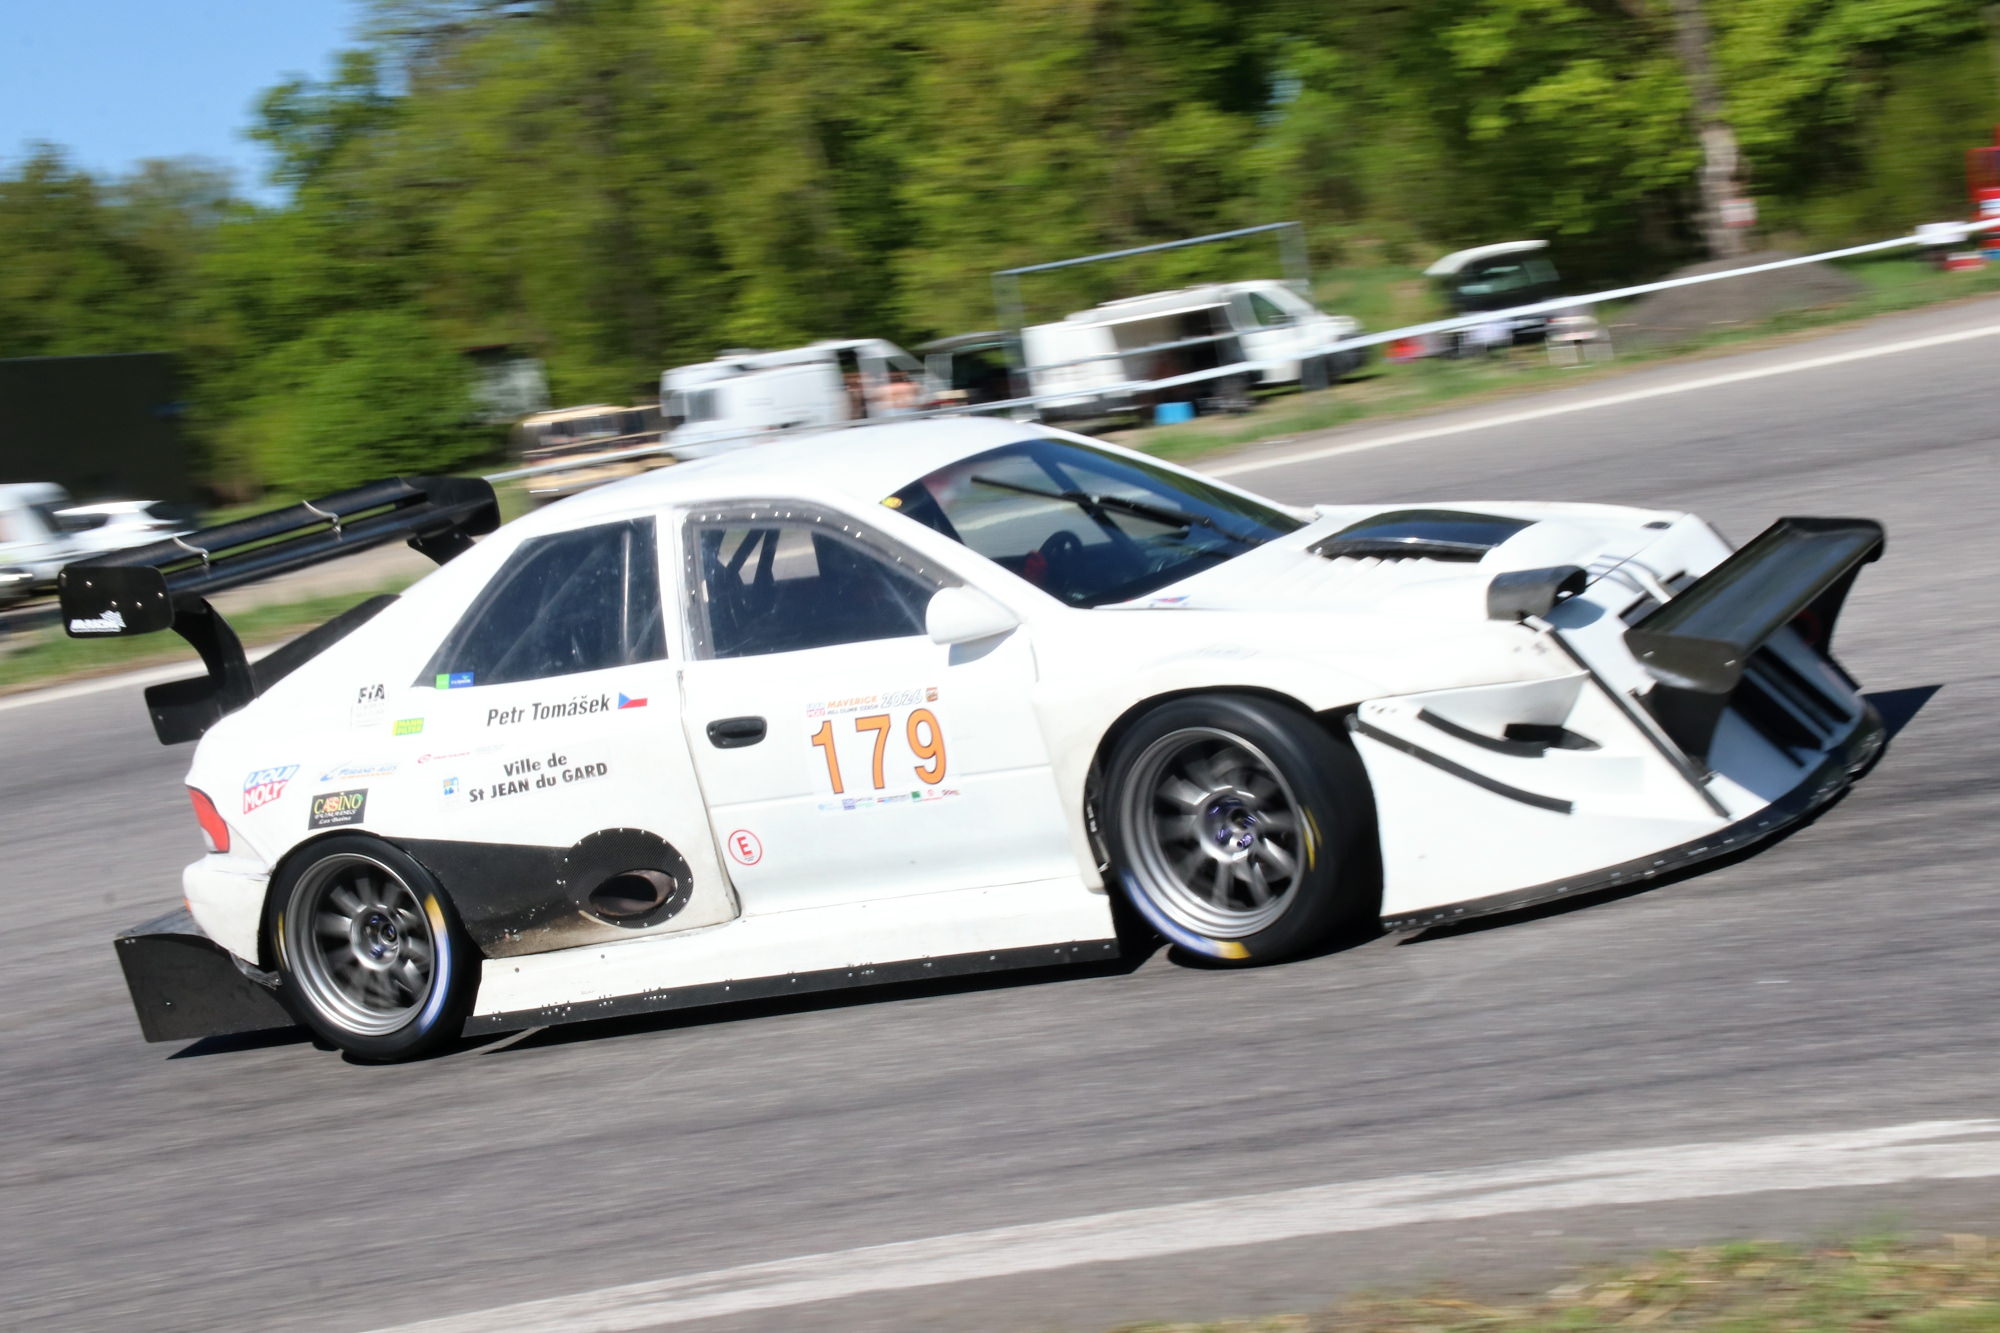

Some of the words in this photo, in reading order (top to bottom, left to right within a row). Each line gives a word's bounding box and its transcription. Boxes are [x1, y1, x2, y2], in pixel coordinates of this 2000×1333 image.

[487, 706, 525, 726] Petr
[531, 693, 611, 720] Tomášek
[503, 757, 541, 777] Ville
[547, 752, 567, 768] de
[811, 708, 947, 794] 179
[244, 781, 285, 812] MOLY
[469, 787, 485, 803] St
[490, 778, 530, 800] JEAN
[535, 773, 557, 790] du
[562, 762, 608, 783] GARD
[314, 792, 363, 814] CASINO
[736, 836, 753, 856] E
